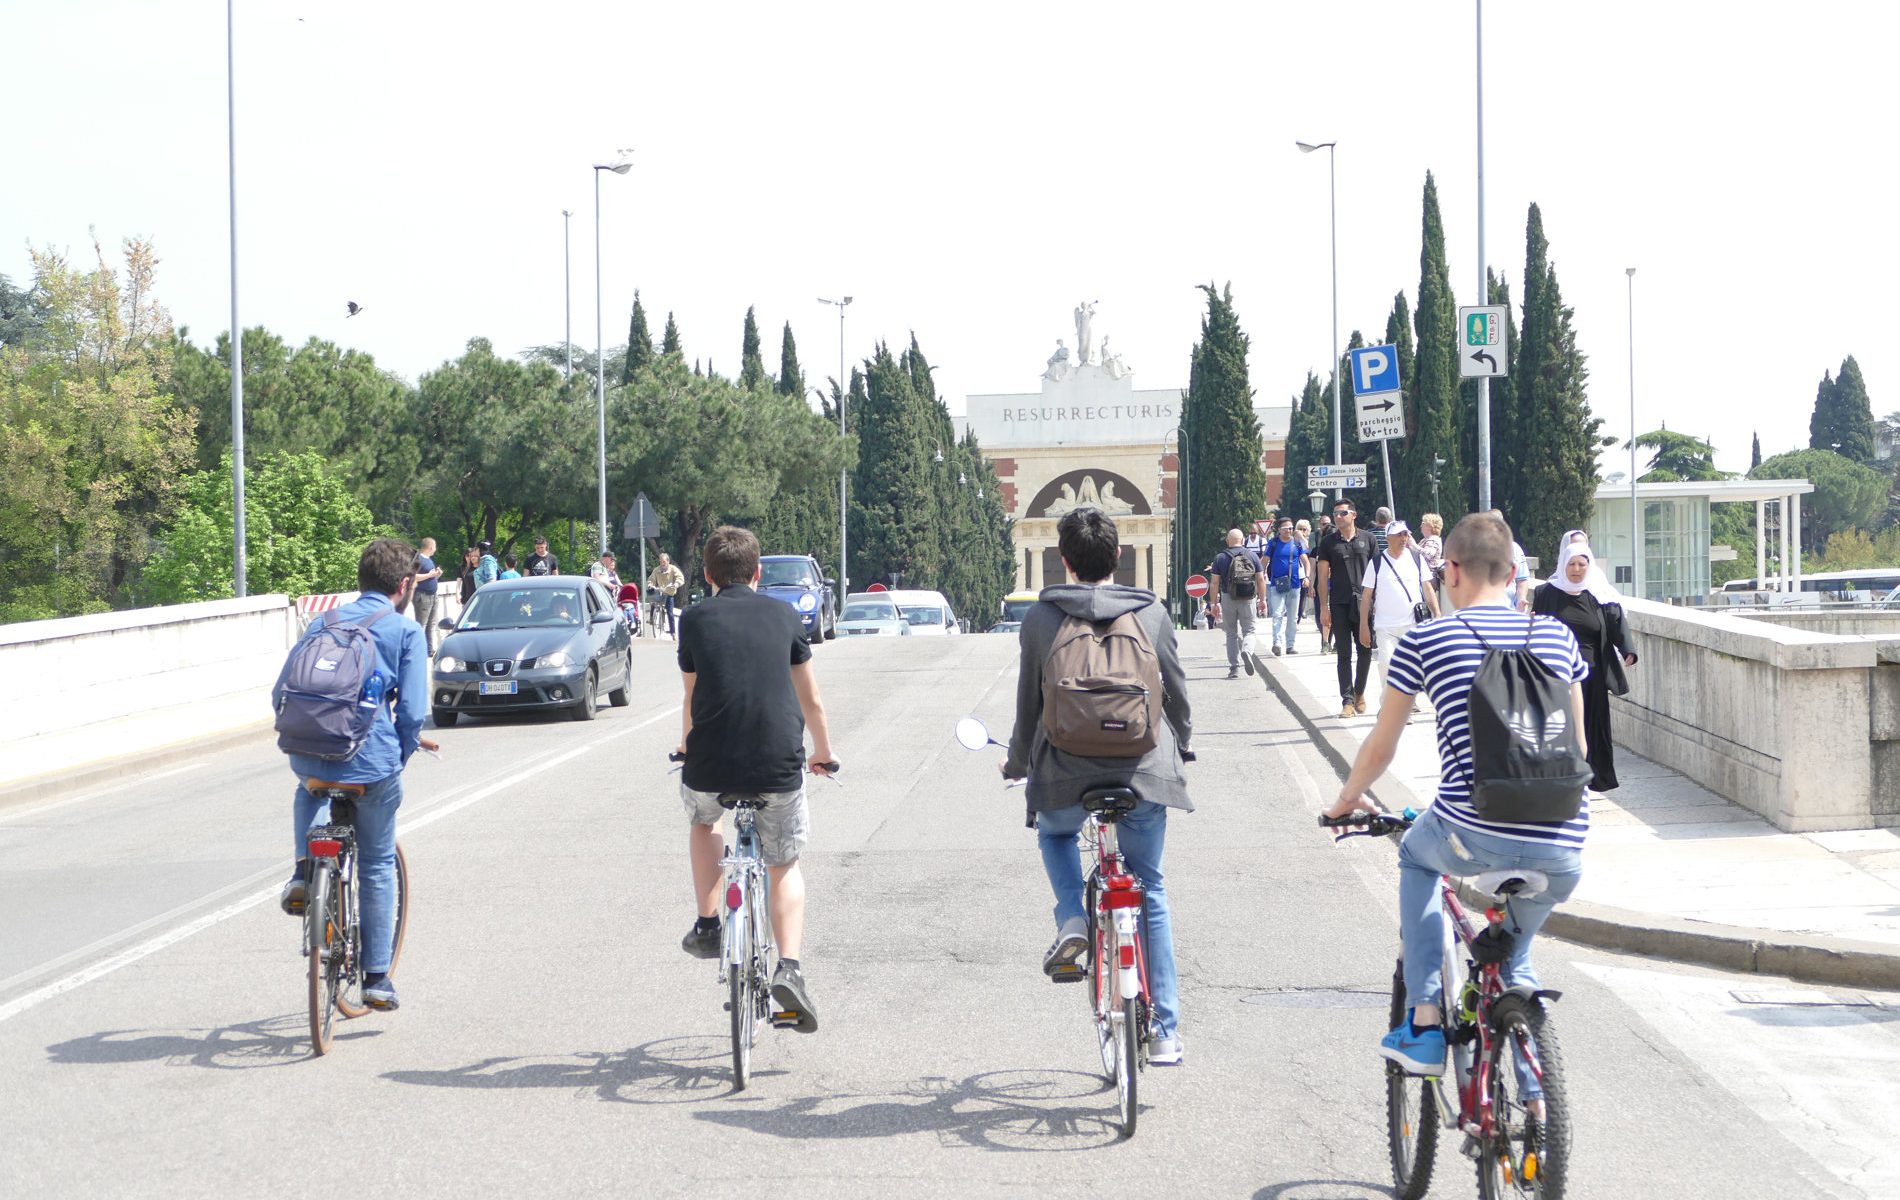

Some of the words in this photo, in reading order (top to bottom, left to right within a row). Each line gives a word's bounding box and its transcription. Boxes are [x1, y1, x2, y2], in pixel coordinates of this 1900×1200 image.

[1359, 351, 1389, 390] P
[1003, 404, 1172, 421] RESURRECTURIS
[1360, 416, 1401, 427] parcheggio
